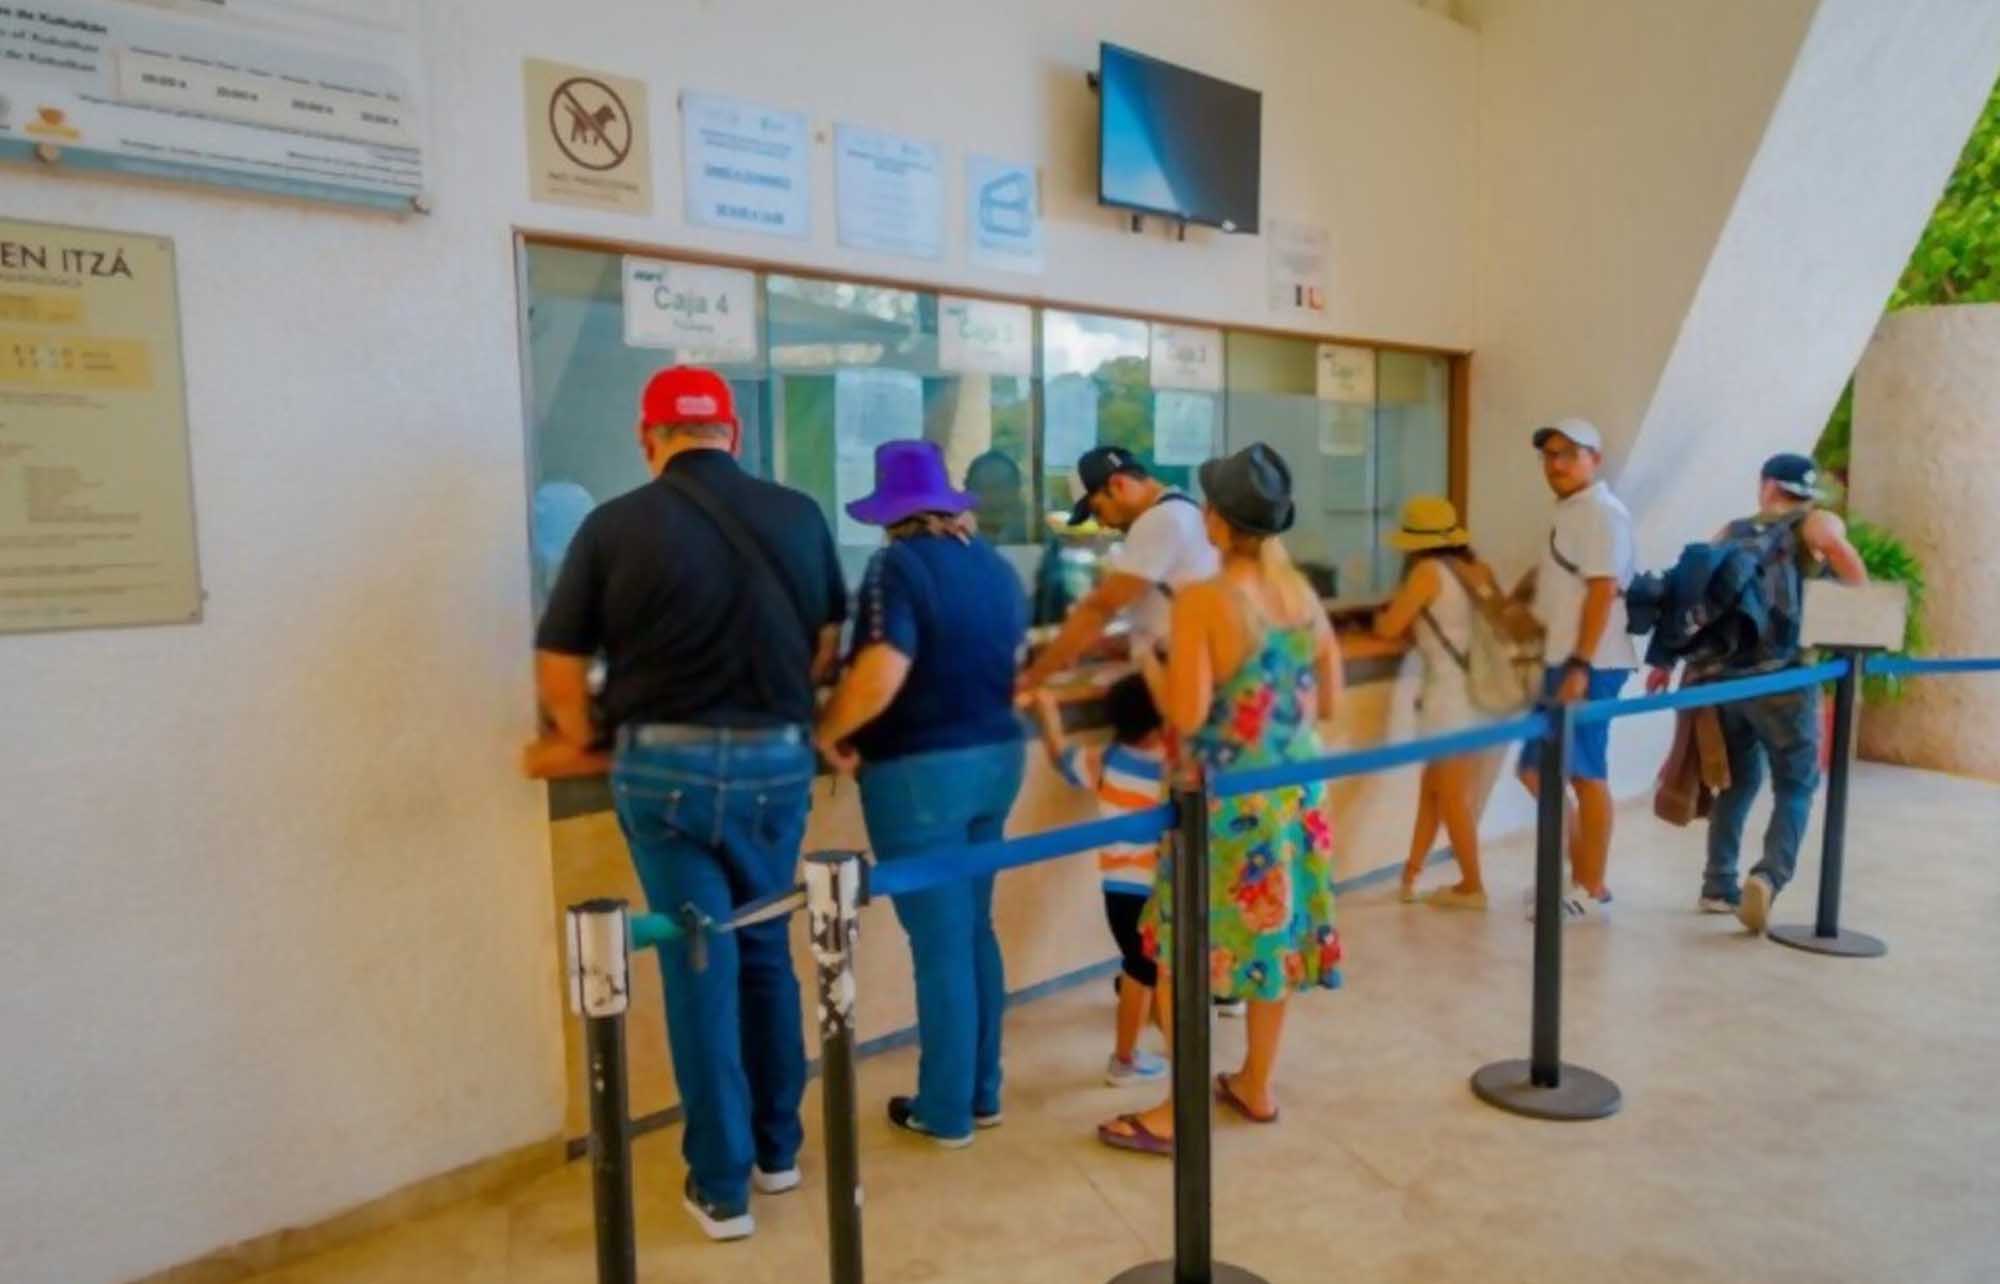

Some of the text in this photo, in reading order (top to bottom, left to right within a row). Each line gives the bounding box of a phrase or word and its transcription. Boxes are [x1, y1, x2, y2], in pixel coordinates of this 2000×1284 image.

[0, 241, 134, 279] EN ITZÁ
[654, 285, 729, 318] Caja 4
